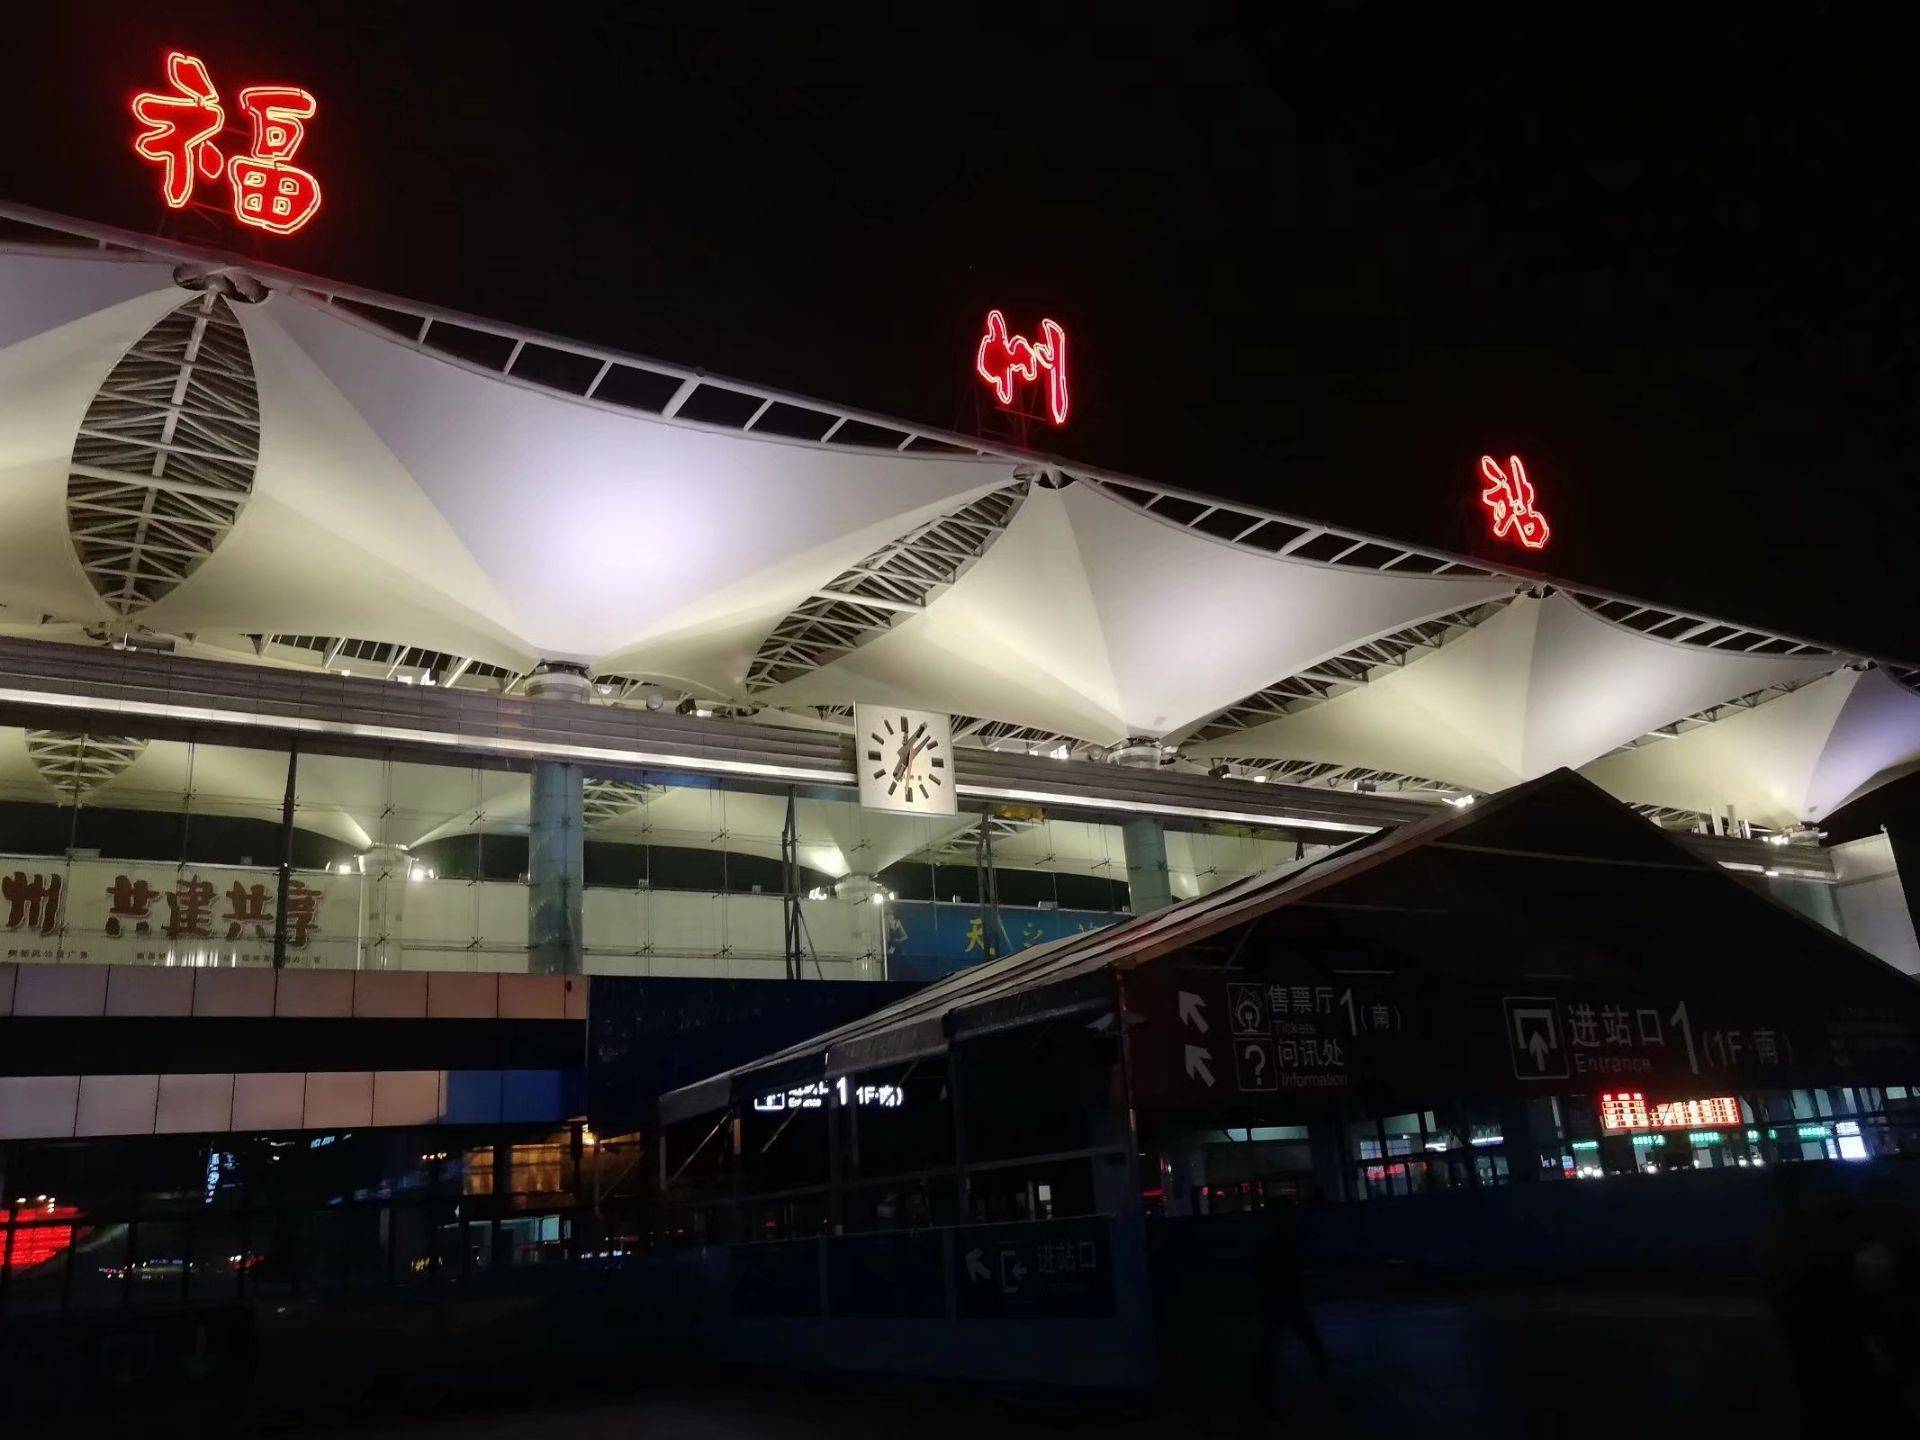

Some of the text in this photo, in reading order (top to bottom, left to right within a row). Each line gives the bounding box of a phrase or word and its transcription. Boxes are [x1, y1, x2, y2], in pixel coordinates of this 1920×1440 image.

[132, 51, 1550, 549] 福 州 站
[1267, 983, 1335, 1015] 售票厅
[1273, 1019, 1319, 1035] Tickets
[1567, 1002, 1665, 1049] 进站口
[1278, 1038, 1345, 1068] 问讯处
[1574, 1052, 1653, 1074] Entrance
[1281, 1071, 1350, 1089] Information
